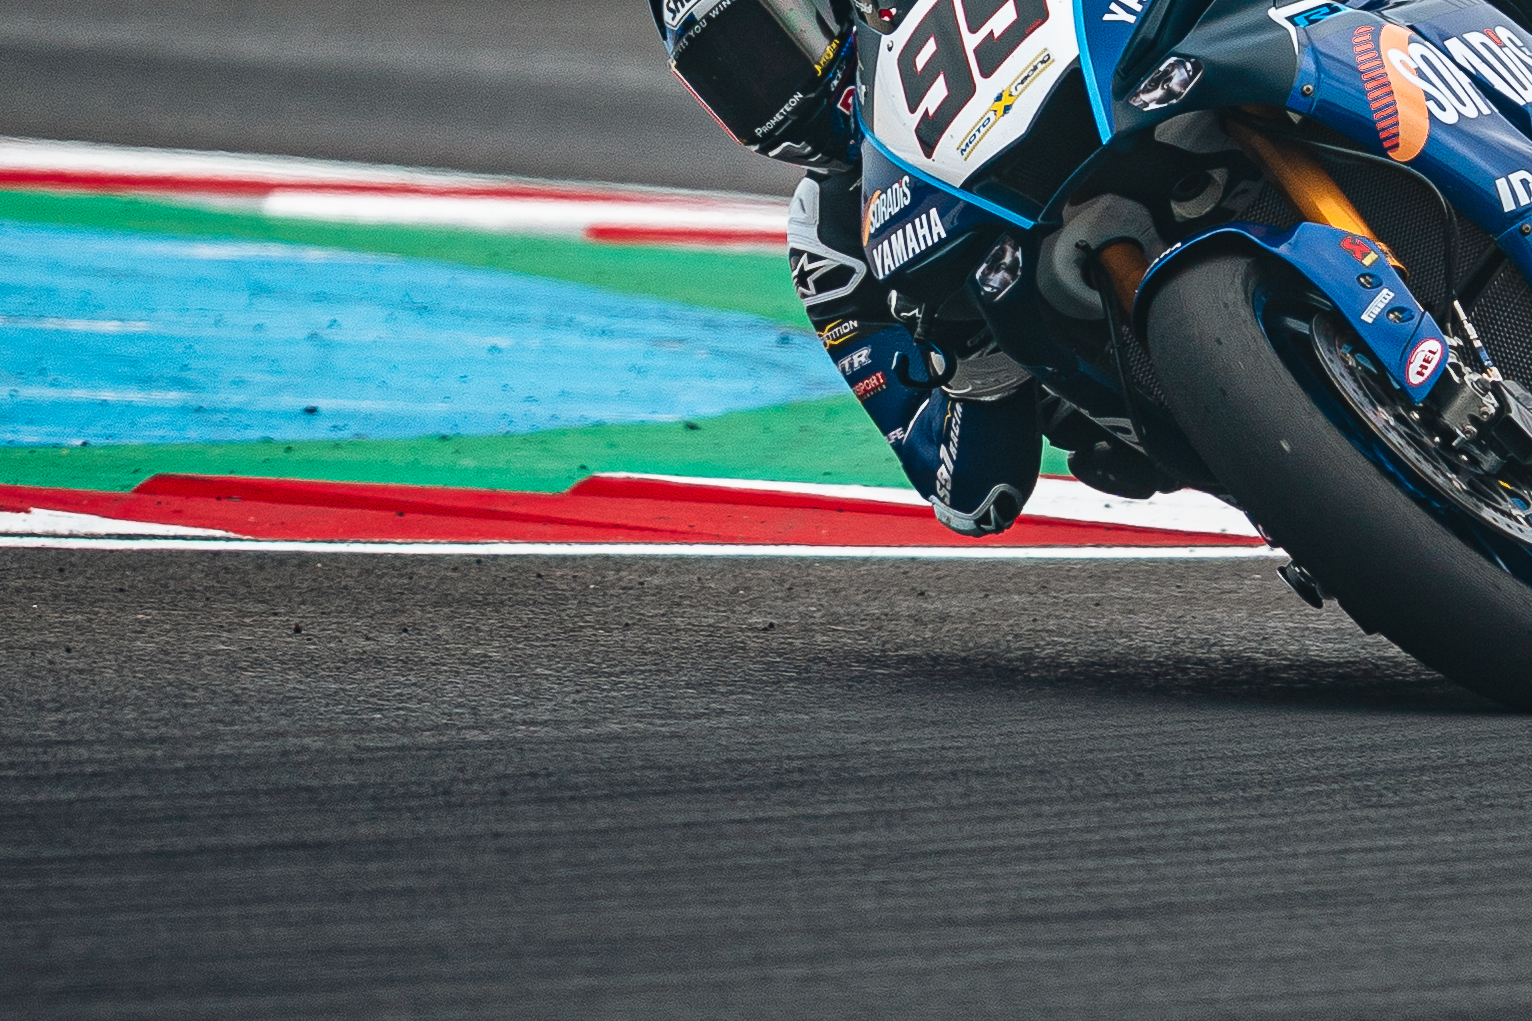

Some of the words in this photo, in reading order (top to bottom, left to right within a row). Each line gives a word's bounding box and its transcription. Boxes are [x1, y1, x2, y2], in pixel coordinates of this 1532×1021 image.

[690, 20, 708, 39] YOU
[754, 91, 804, 138] PROMETEON
[959, 116, 991, 157] MOTO
[1014, 53, 1051, 92] racing
[872, 207, 947, 280] YAMAHA
[1415, 348, 1439, 377] HEL
